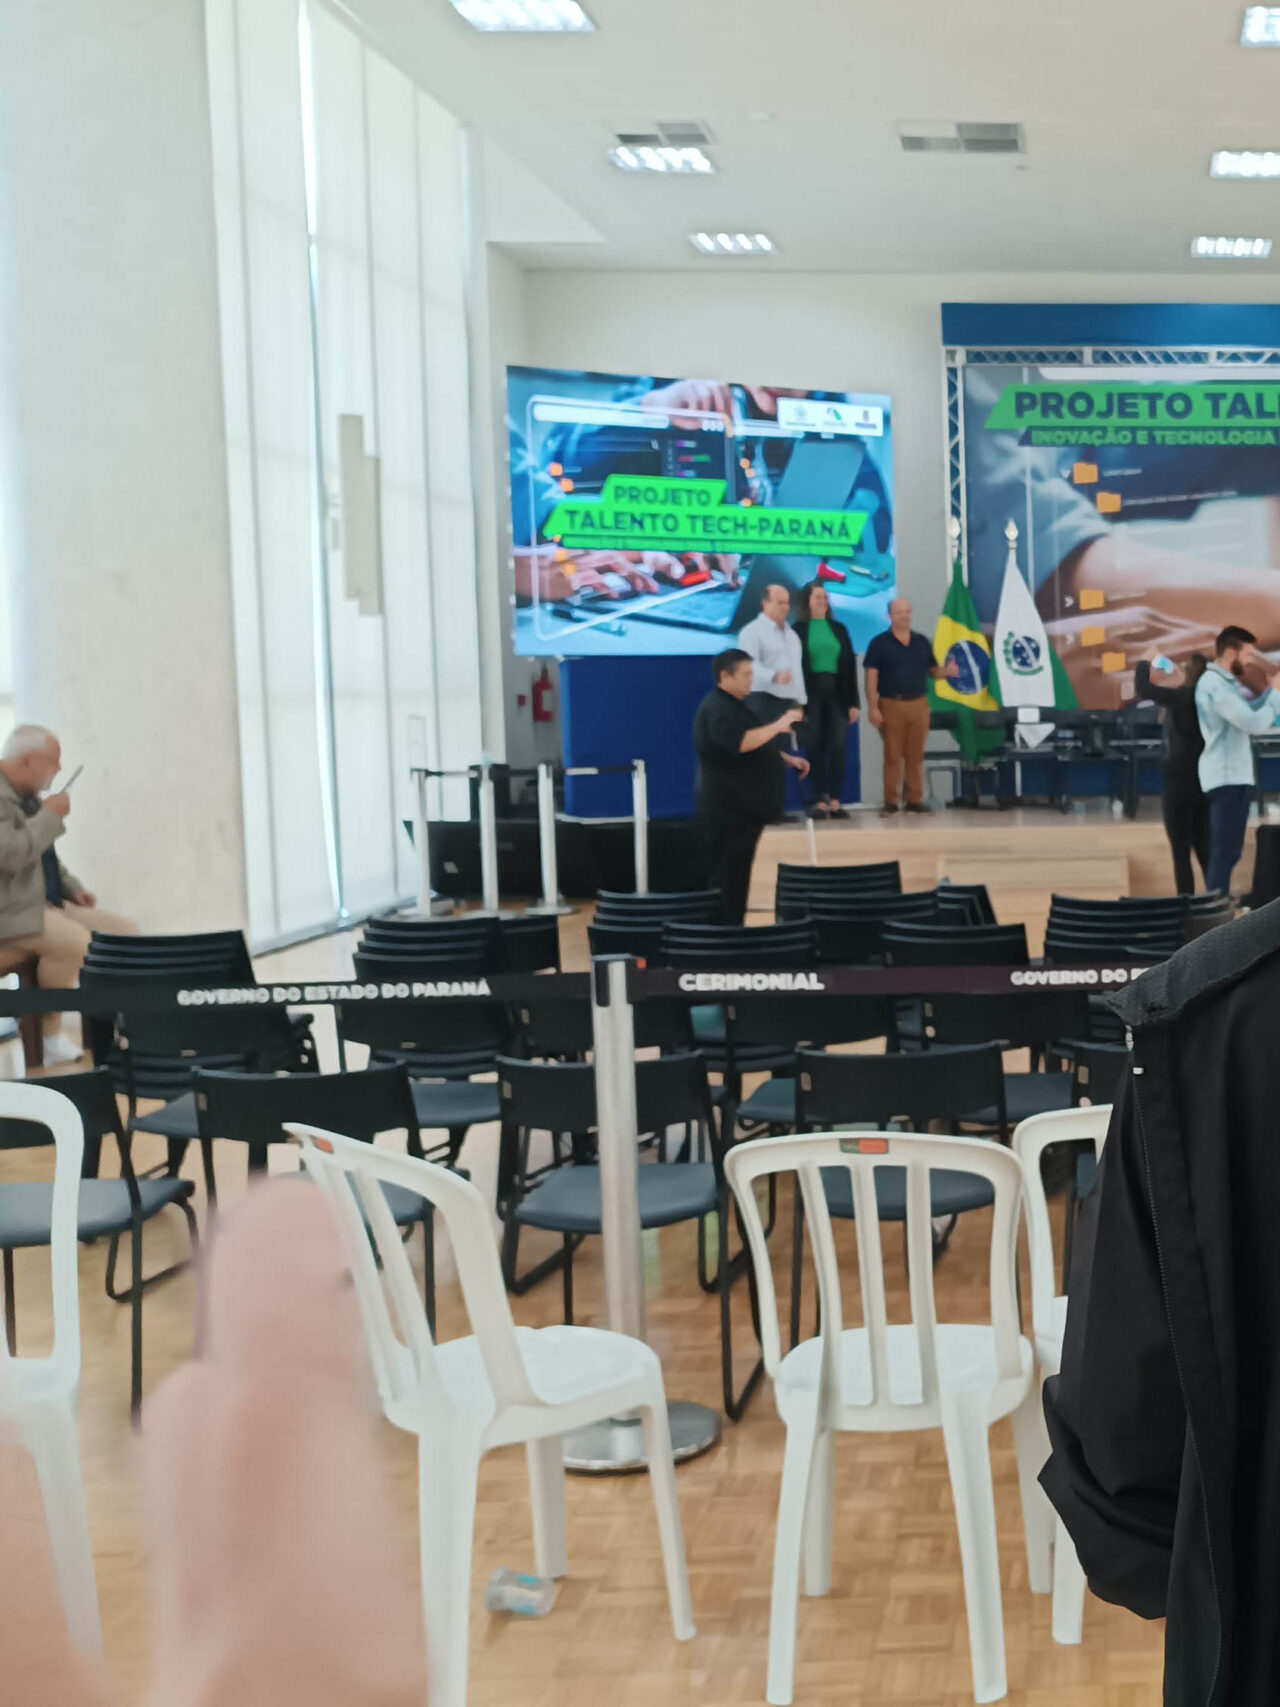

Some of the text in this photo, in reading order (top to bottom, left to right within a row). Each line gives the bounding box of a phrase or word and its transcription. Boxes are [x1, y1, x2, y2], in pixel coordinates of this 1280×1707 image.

[1014, 391, 1193, 420] PROJETO
[1031, 426, 1133, 447] INOVAÇÃO
[1136, 430, 1149, 445] E
[1153, 430, 1276, 446] TECNOLOGIA
[613, 484, 712, 508] PROJETO
[565, 509, 852, 540] TALENTO TECH-PARANÁ
[678, 972, 825, 992] CERIMONIAL
[1010, 969, 1099, 986] GOVERNO
[1101, 968, 1128, 983] DO
[176, 977, 492, 1006] GOVERNO DO ESTADO DO PARANÁ
